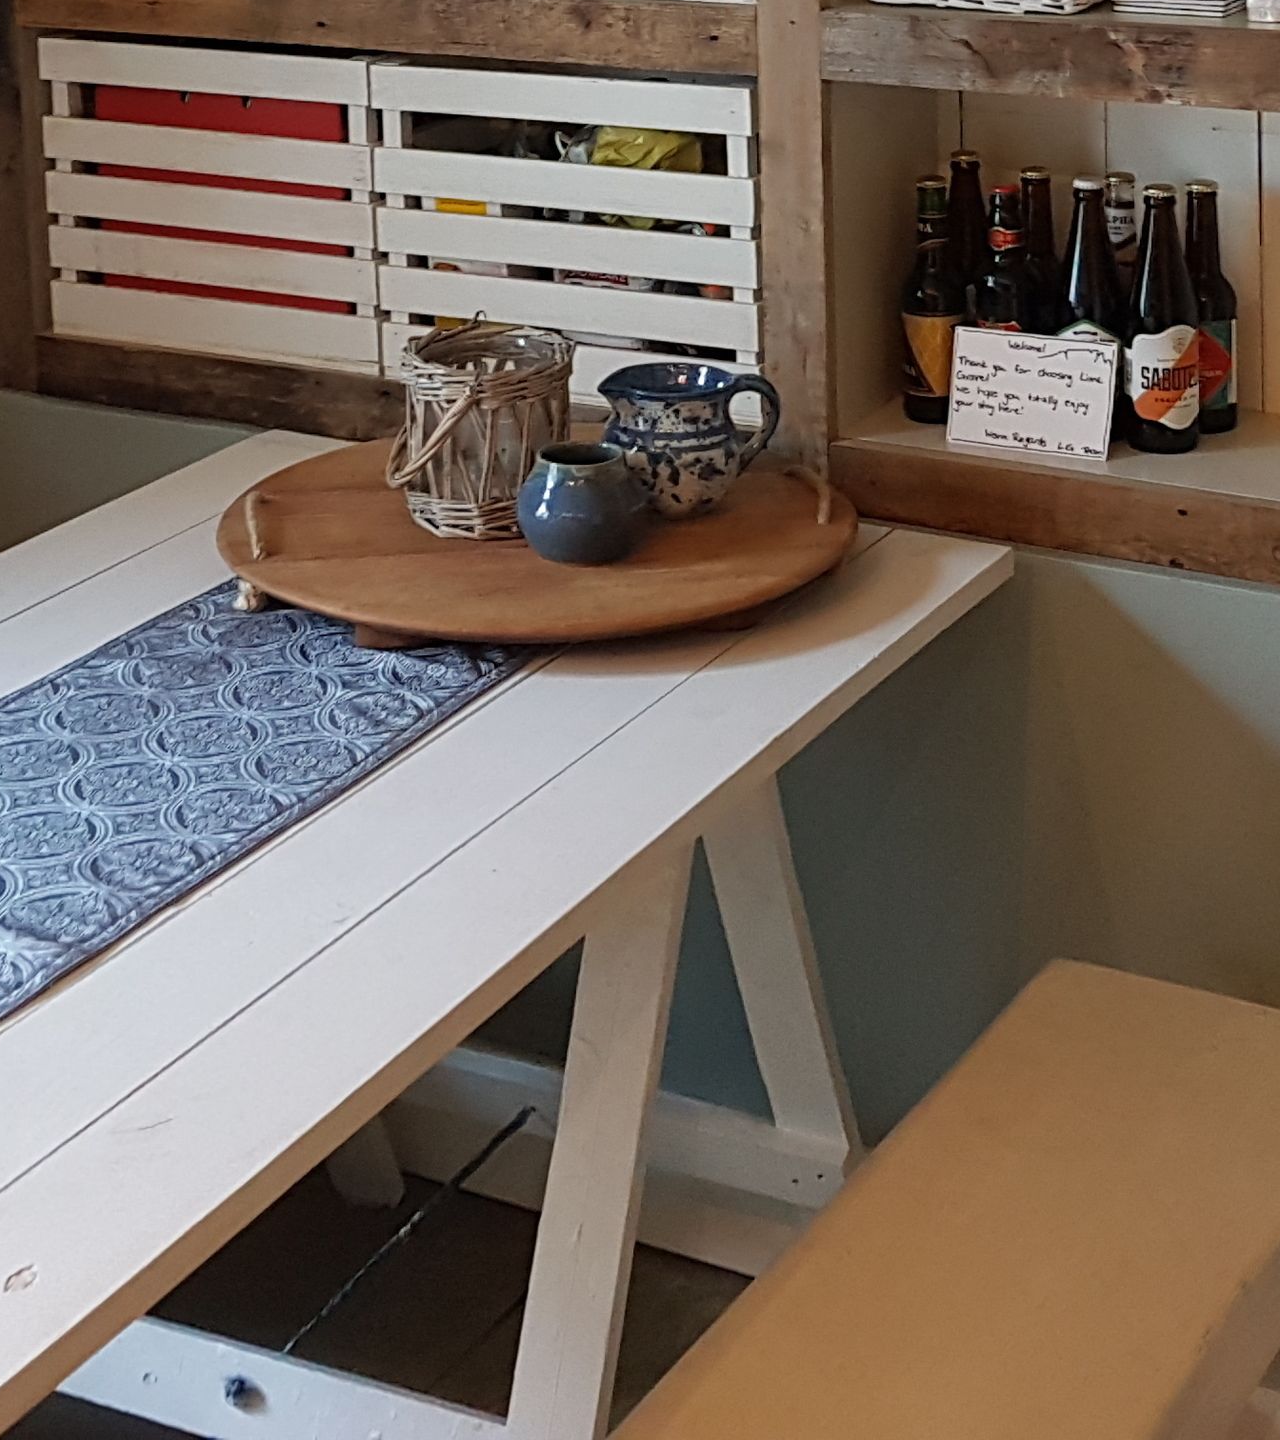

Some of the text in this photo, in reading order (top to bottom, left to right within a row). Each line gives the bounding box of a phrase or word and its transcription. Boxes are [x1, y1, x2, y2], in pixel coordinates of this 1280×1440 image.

[1007, 340, 1047, 353] Welcome!
[958, 356, 988, 369] Thank
[993, 364, 1007, 378] you
[1015, 364, 1031, 374] for
[1079, 372, 1104, 384] Lime
[952, 399, 973, 412] your
[978, 400, 995, 416] stay
[977, 386, 998, 399] hope
[1004, 393, 1021, 405] you
[1028, 392, 1059, 411] totally
[1064, 399, 1090, 415] enjoy
[1012, 432, 1048, 448] Regards
